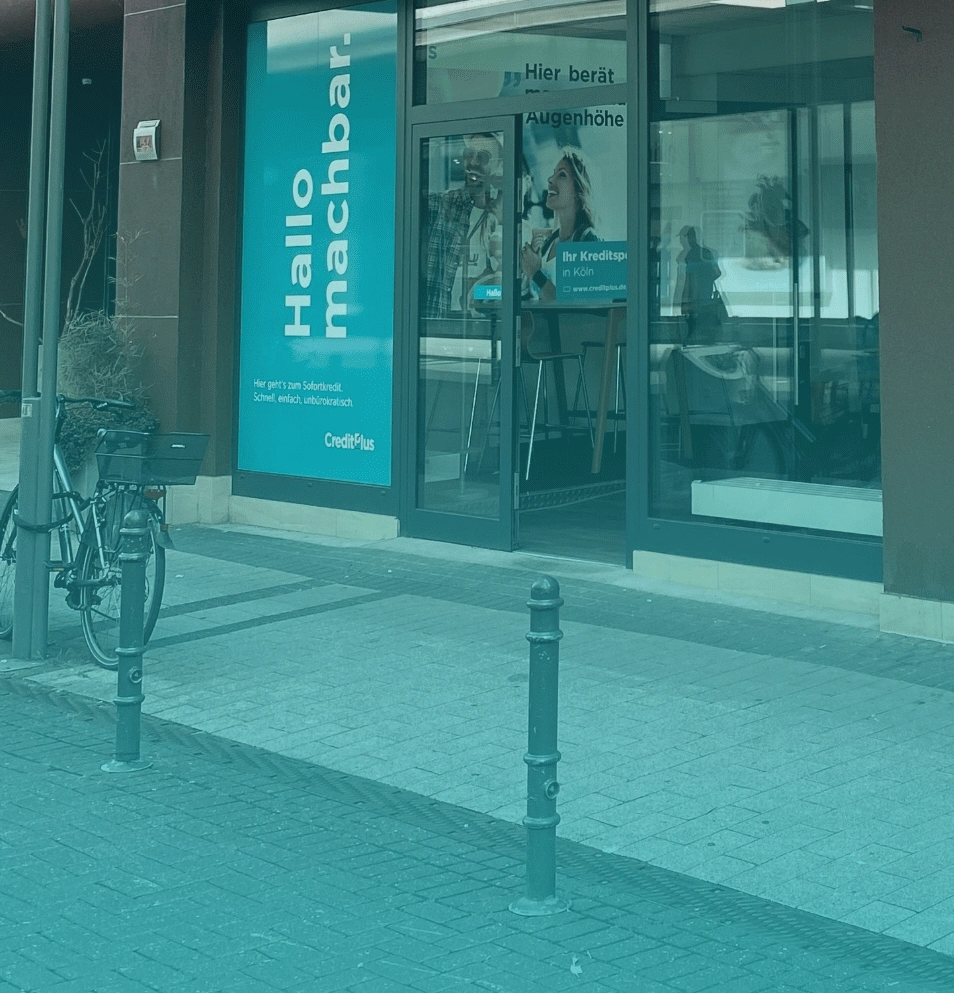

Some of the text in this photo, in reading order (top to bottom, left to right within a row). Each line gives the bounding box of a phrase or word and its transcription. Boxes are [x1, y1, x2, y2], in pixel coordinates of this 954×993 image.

[525, 63, 615, 84] Hier berät
[525, 109, 625, 128] Augenhöhe
[320, 32, 351, 339] machbar.
[284, 168, 314, 337] Hallo
[562, 251, 576, 262] Ihr
[562, 266, 594, 277] in Köln
[253, 379, 266, 388] Hier
[287, 382, 302, 390] zum
[302, 381, 343, 393] Sofortkredit.
[324, 432, 375, 451] CreditPlus
